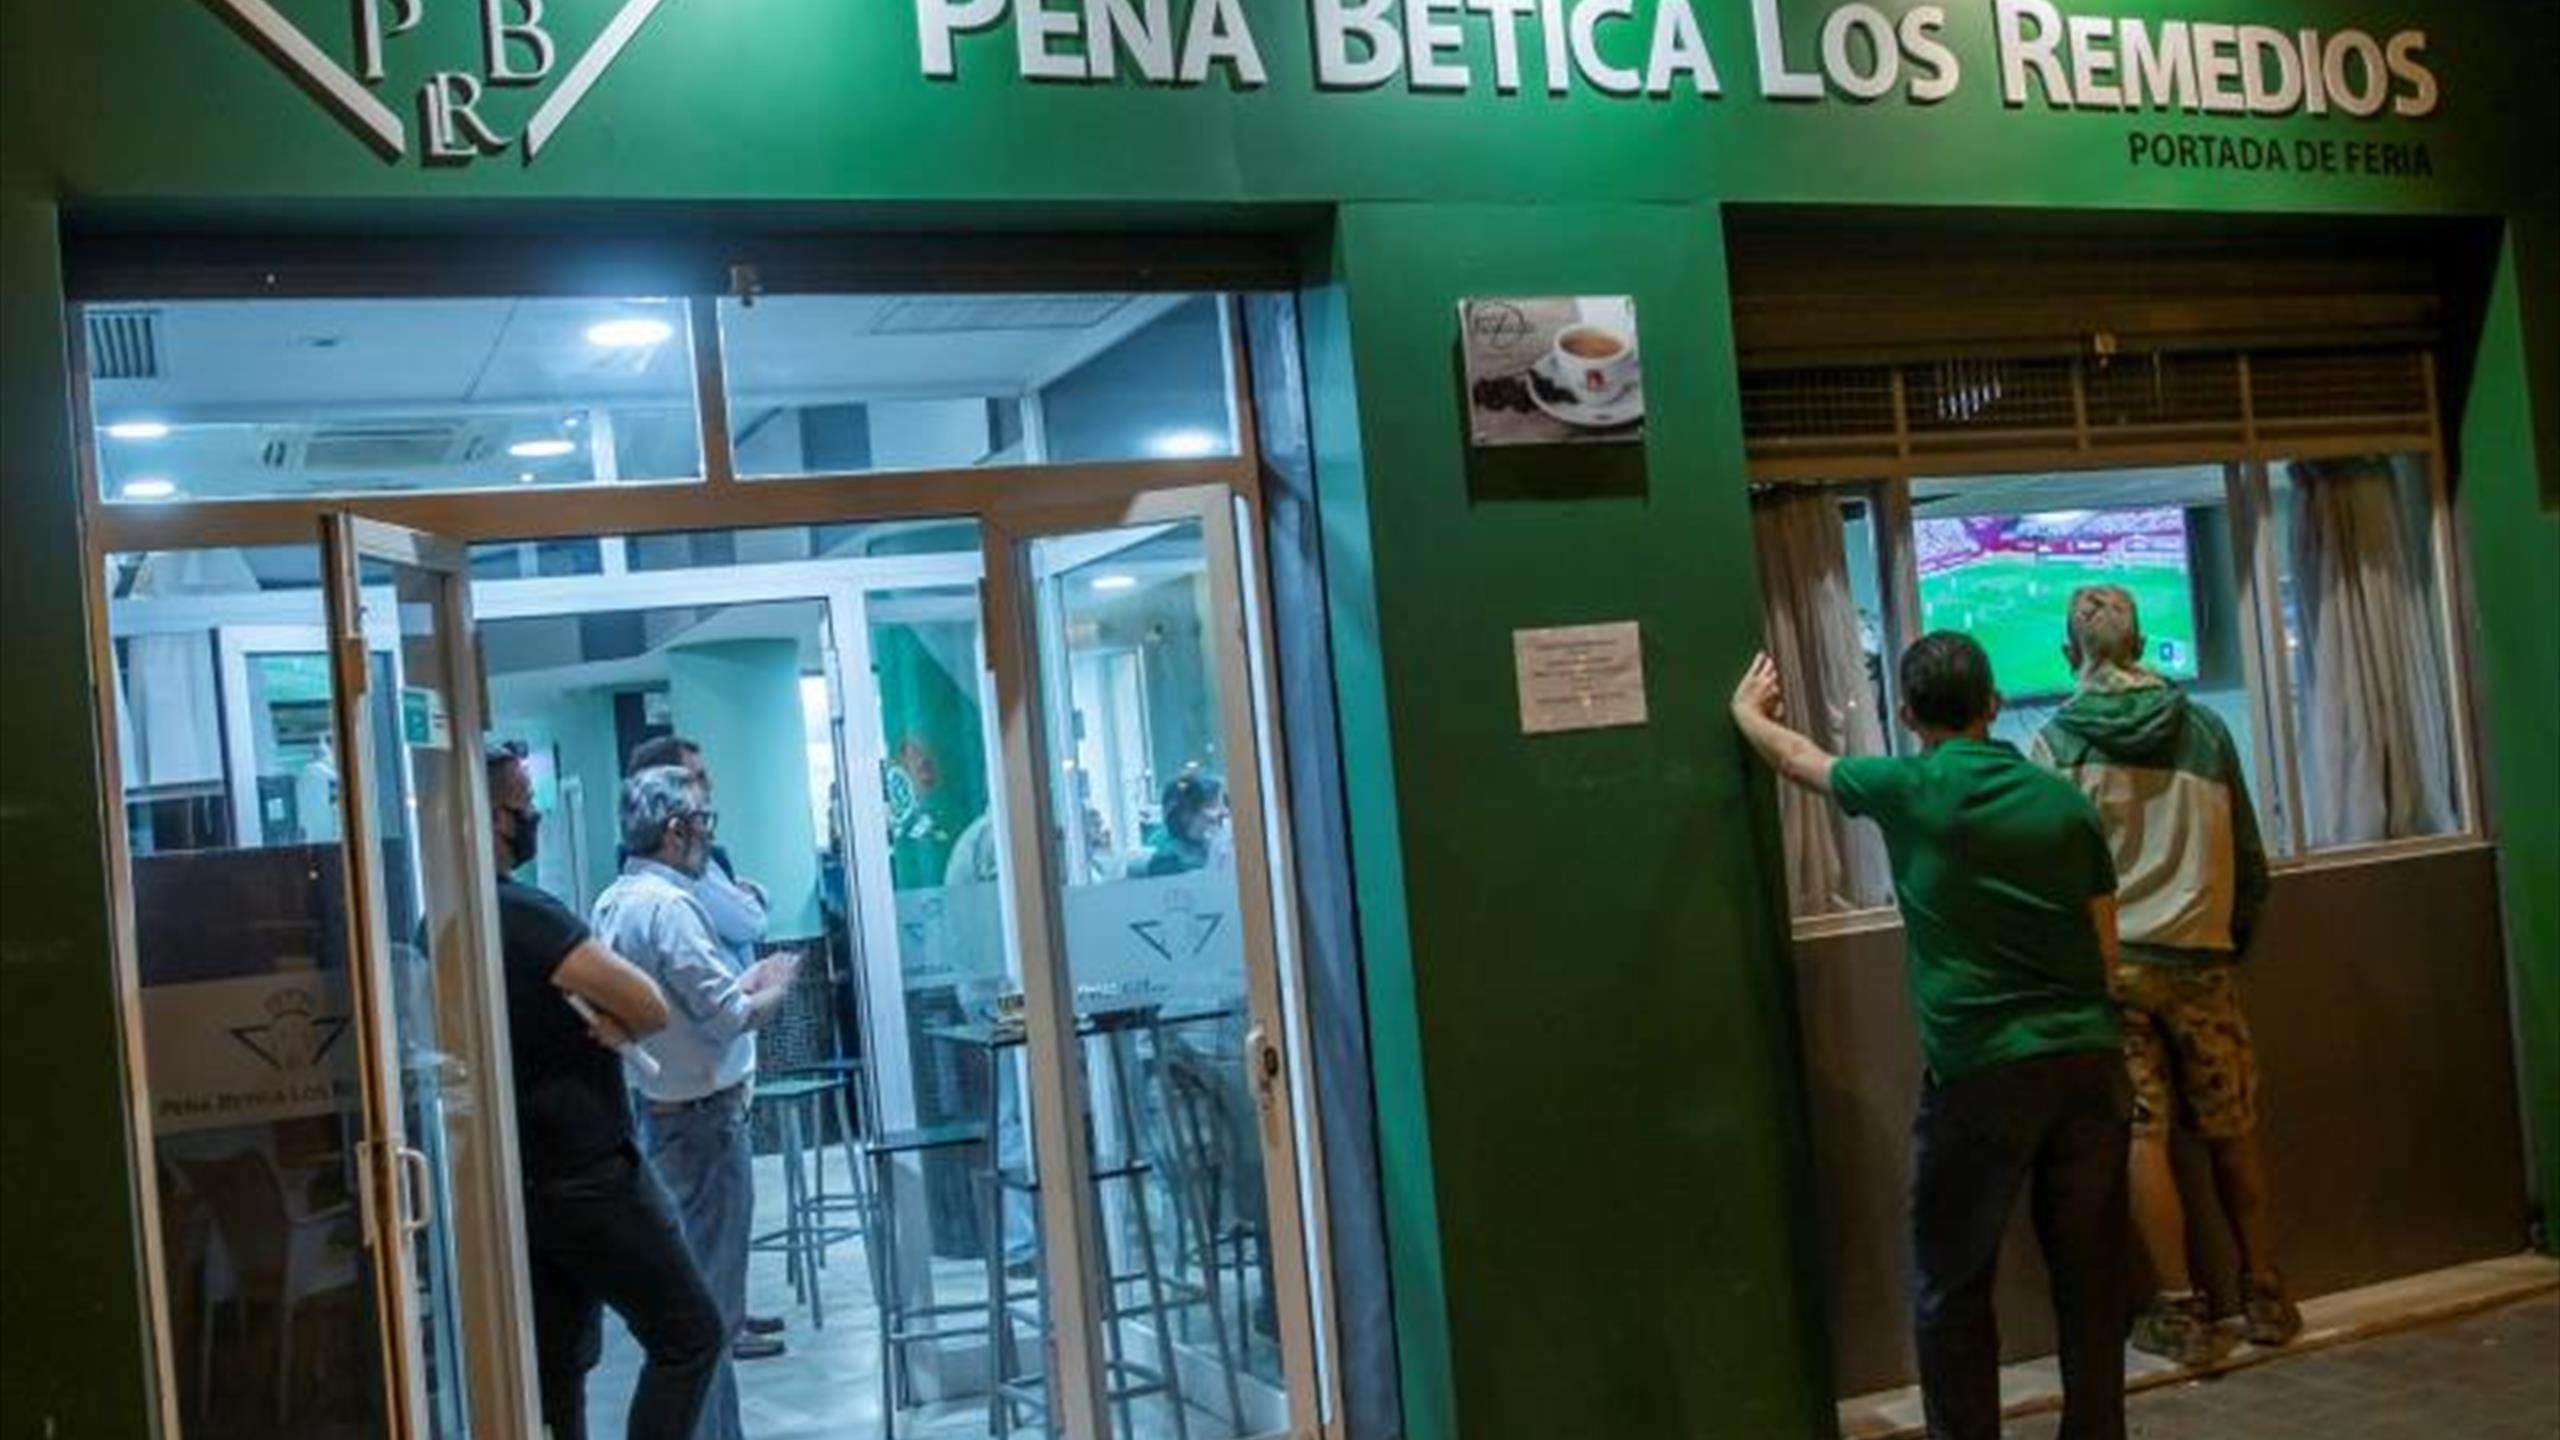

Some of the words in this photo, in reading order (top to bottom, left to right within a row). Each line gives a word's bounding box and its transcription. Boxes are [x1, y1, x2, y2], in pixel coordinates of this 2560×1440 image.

[1751, 0, 1960, 101] LOS
[2001, 0, 2440, 117] REMEDIOS
[2128, 131, 2290, 171] PORTADA
[2296, 140, 2338, 173] DE
[2344, 142, 2433, 176] FERIA
